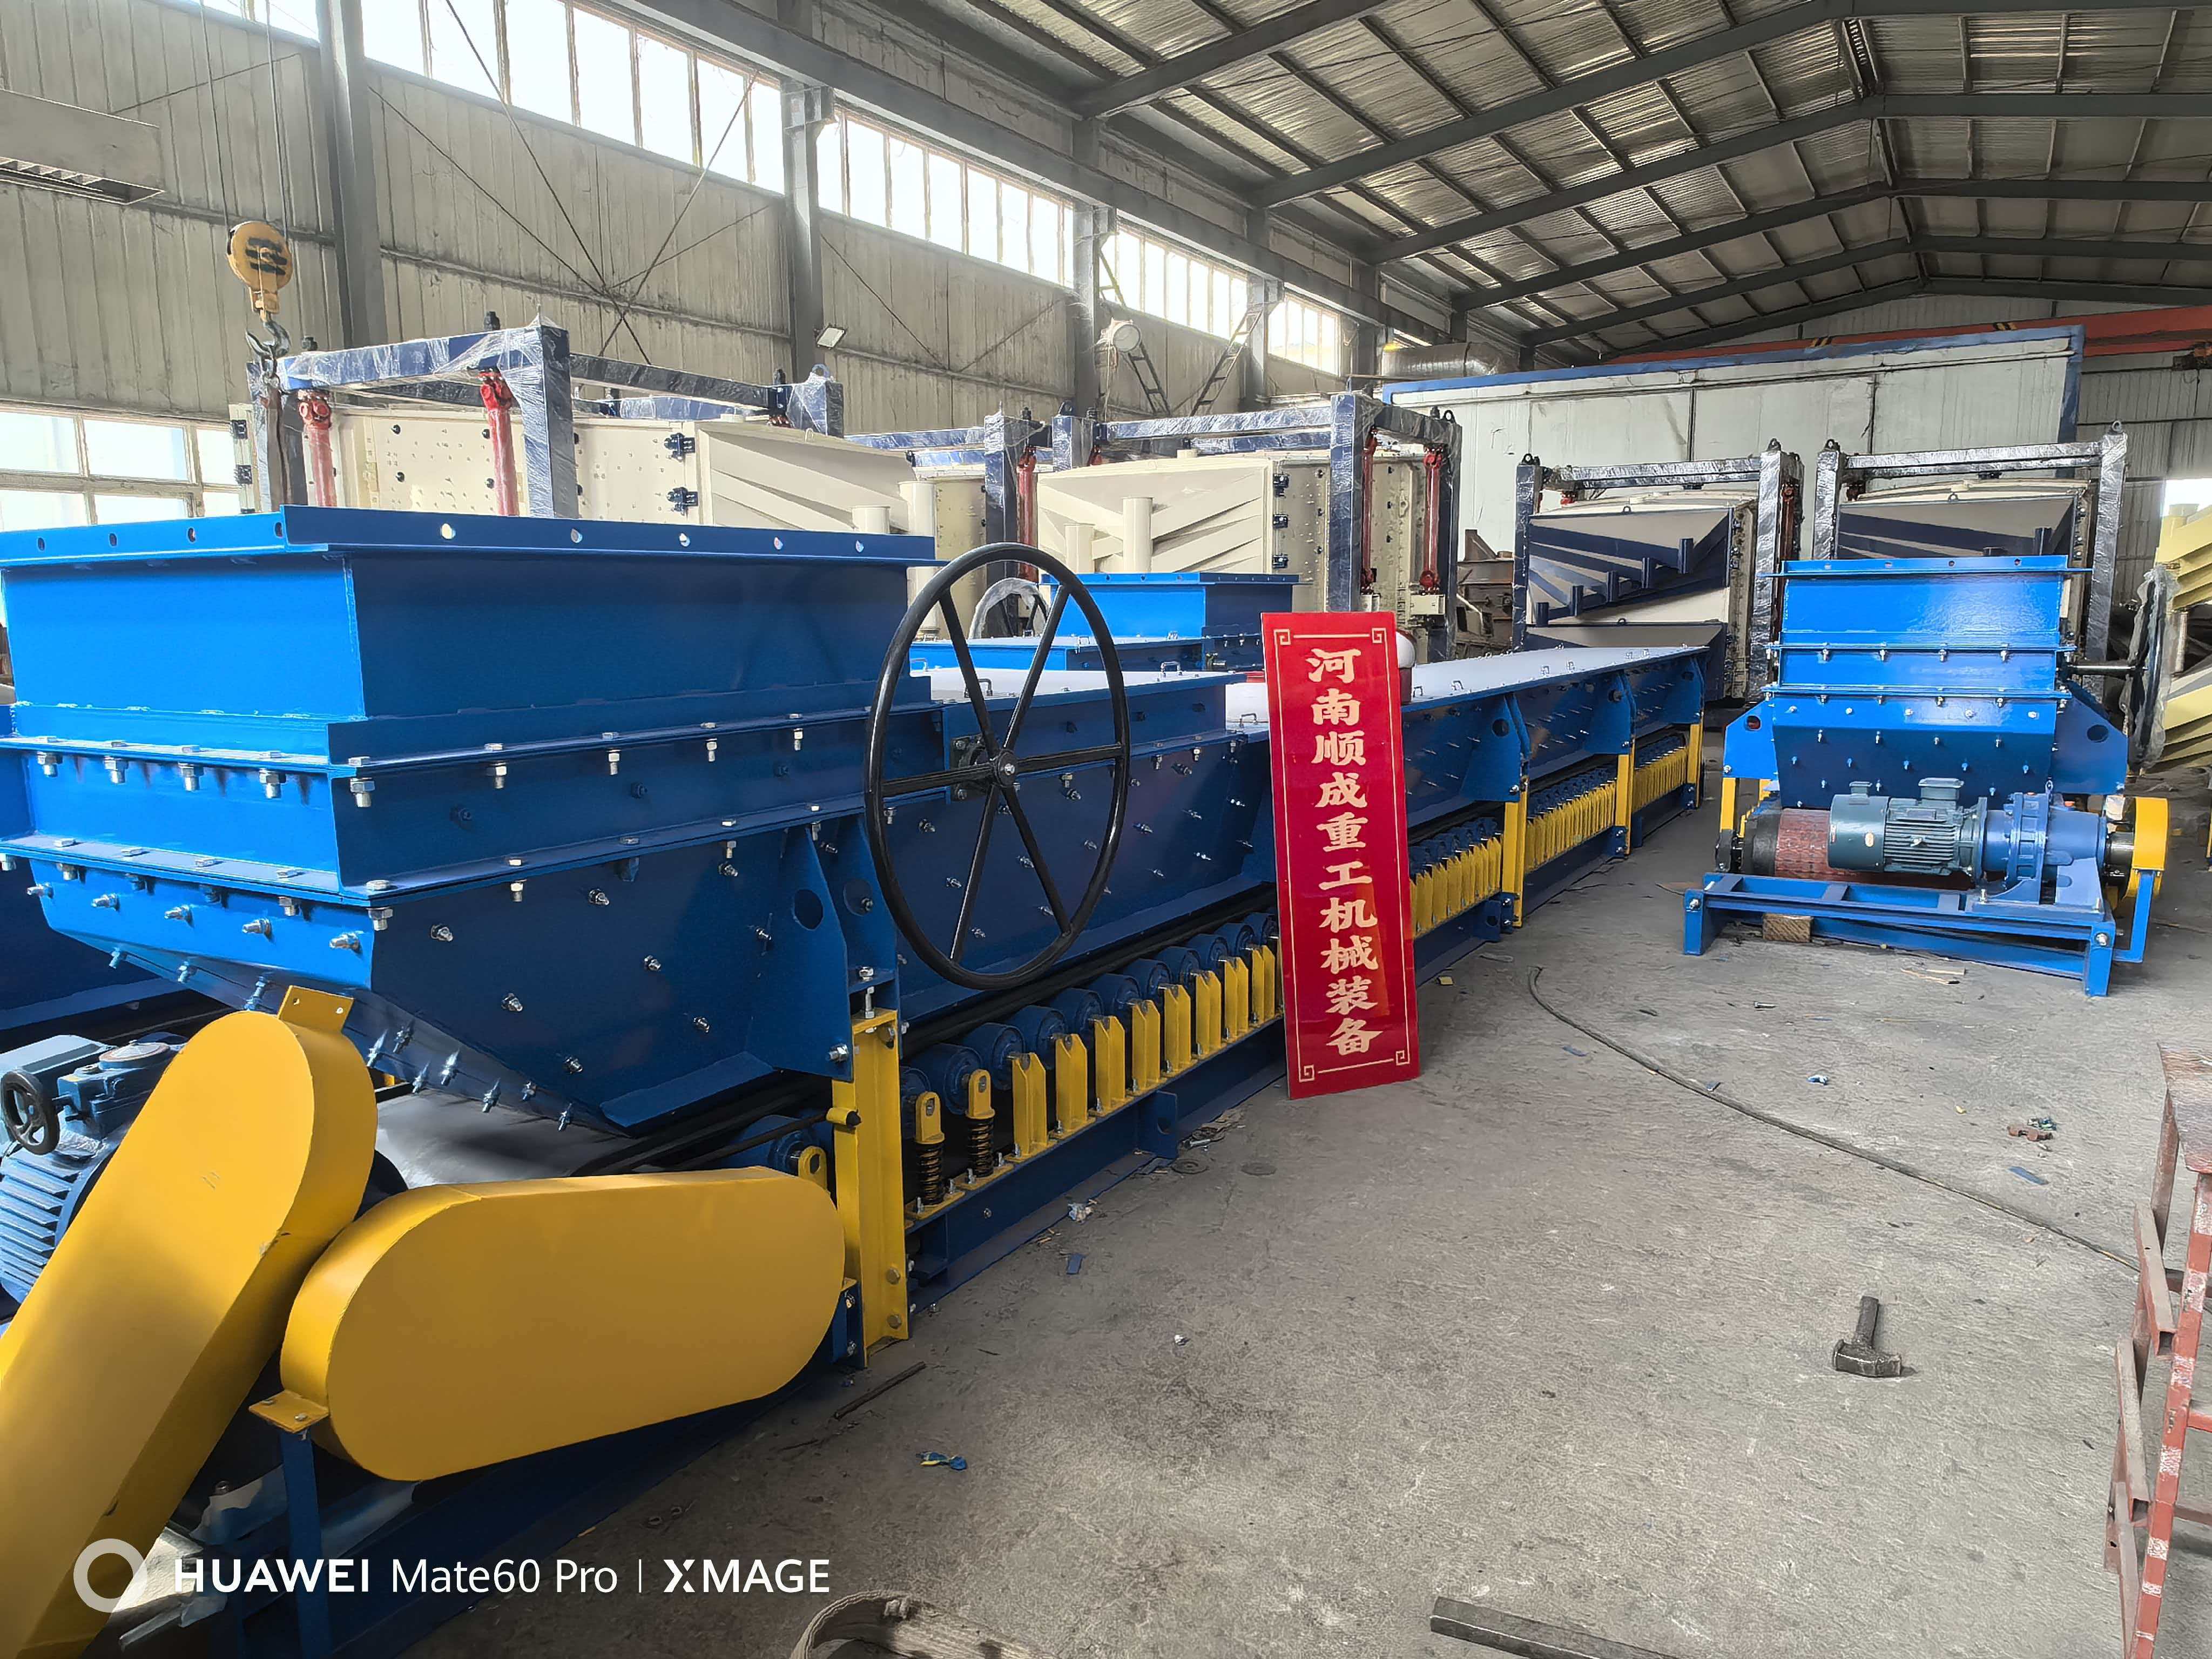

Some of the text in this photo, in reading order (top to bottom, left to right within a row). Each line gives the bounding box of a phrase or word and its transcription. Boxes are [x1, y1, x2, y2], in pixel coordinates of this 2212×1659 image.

[1305, 648, 1383, 1055] 河南顺成重工机械装备
